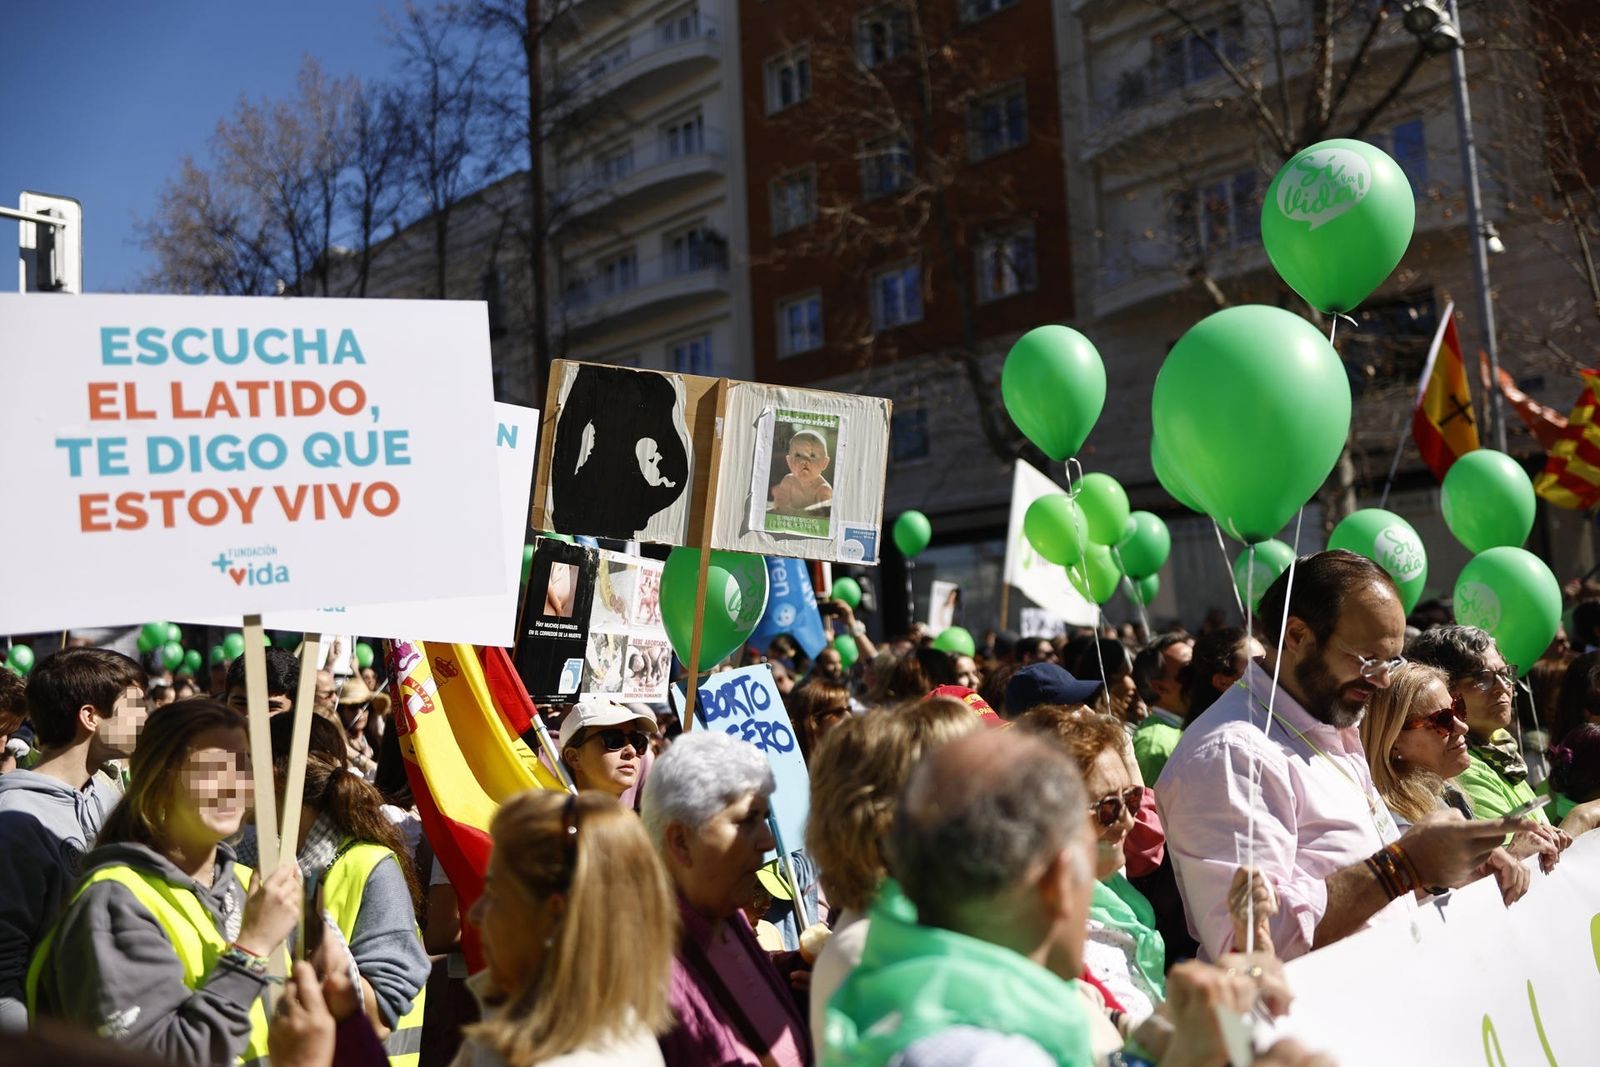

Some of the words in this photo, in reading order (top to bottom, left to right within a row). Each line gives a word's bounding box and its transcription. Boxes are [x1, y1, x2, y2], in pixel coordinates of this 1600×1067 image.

[1296, 155, 1345, 187] Sí
[99, 327, 365, 366] ESCUCHA
[88, 382, 157, 421] EL
[170, 379, 380, 422] LATIDO,
[55, 438, 129, 478] TE
[146, 431, 288, 475] DIGO
[302, 429, 411, 469] QUE
[78, 486, 263, 533] ESTOY
[273, 481, 400, 522] VIVO
[228, 544, 278, 558] FUNDACIÓN
[535, 620, 544, 628] HAY
[559, 623, 578, 631] ESPAÑOLES
[698, 674, 771, 723] BORTO
